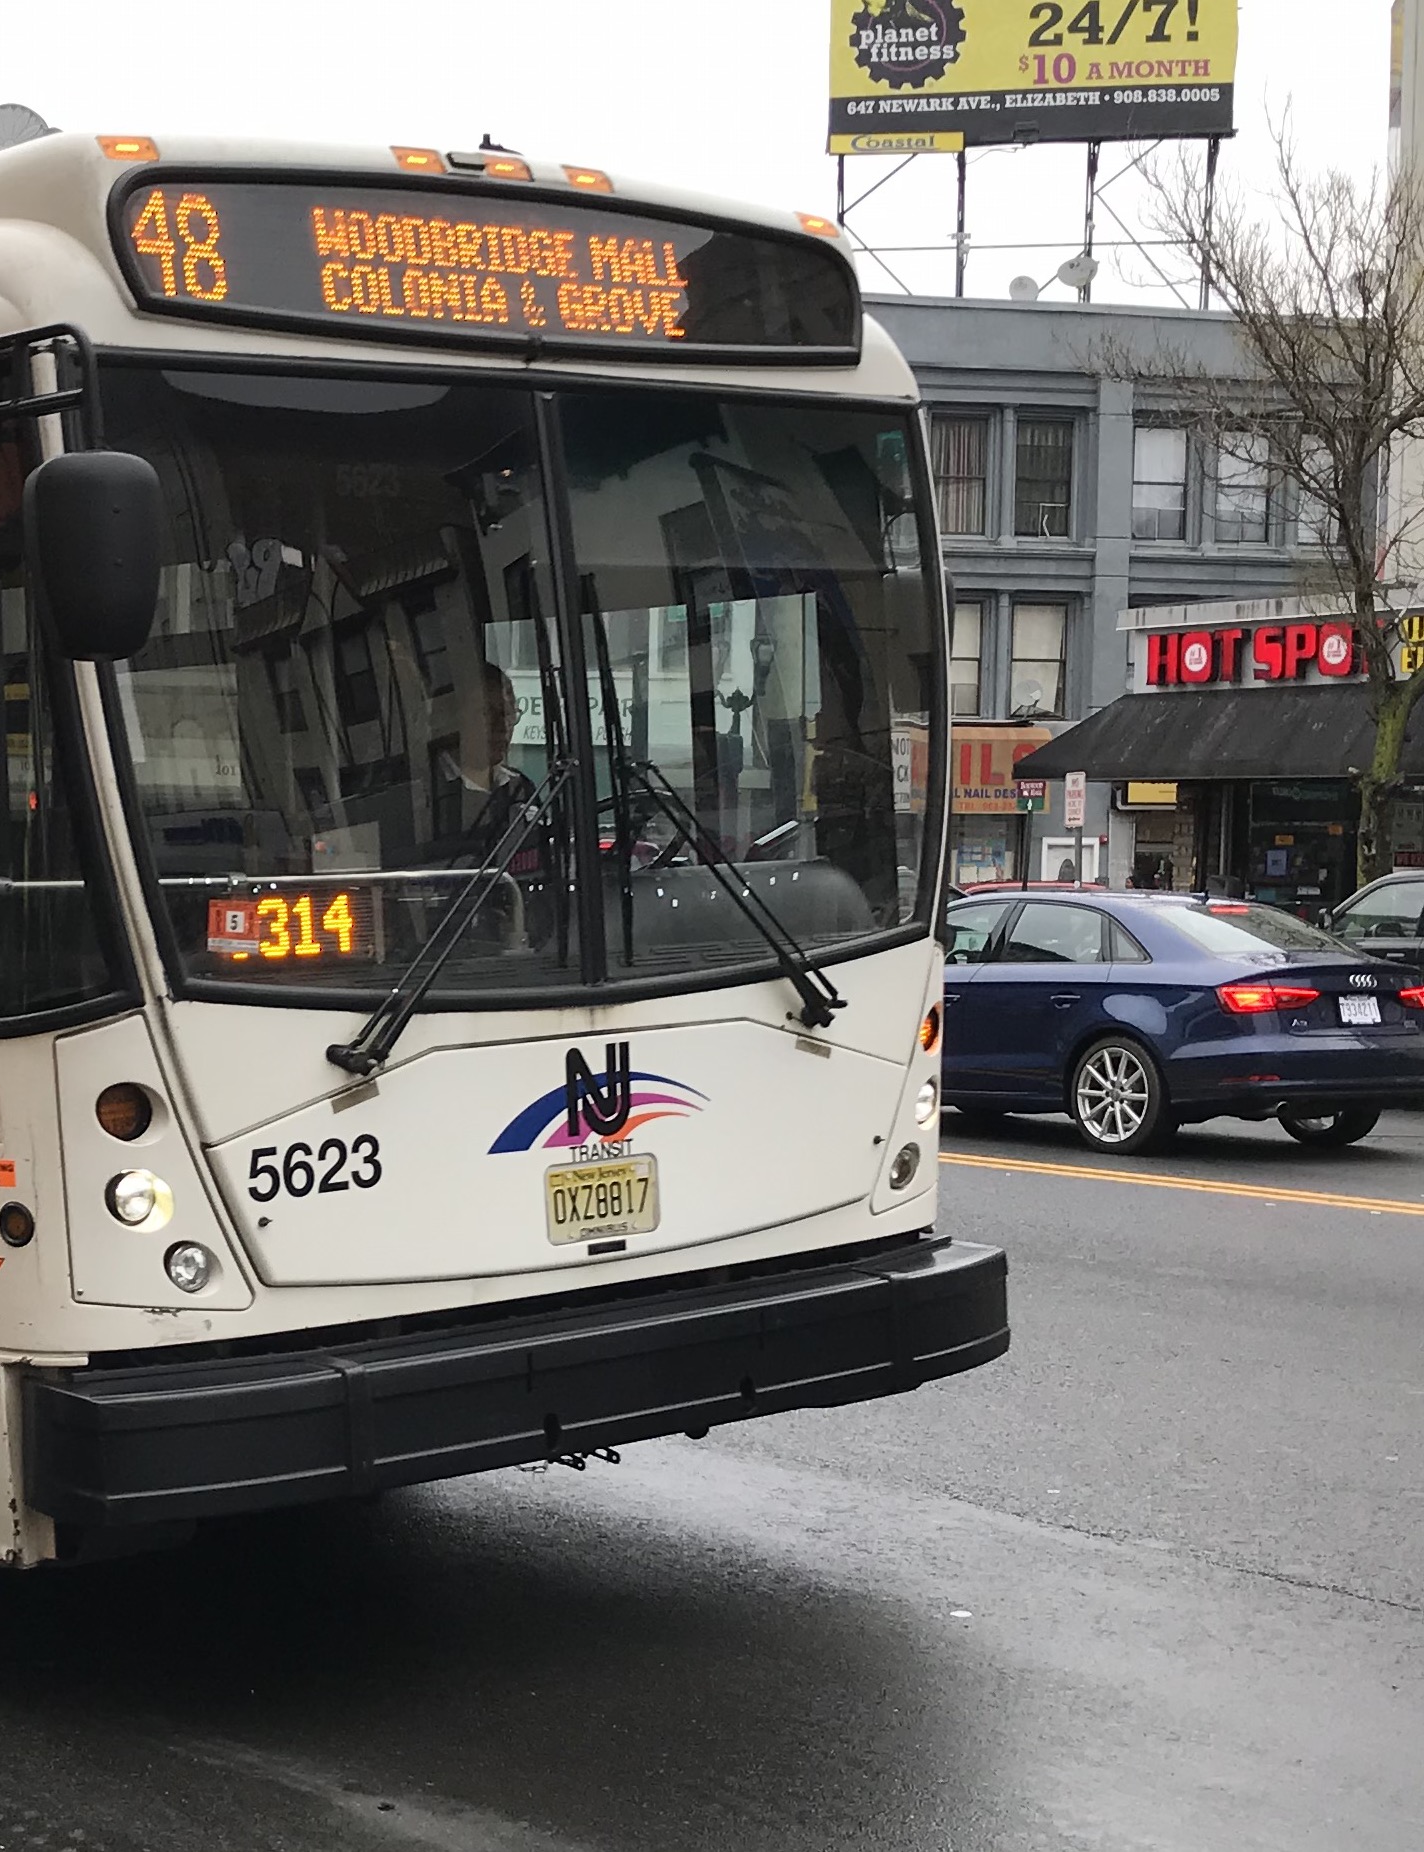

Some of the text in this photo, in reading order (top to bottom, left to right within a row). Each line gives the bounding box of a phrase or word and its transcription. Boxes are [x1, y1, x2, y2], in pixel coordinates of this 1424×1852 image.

[859, 23, 938, 49] planet
[1028, 0, 1199, 47] 24/7!
[870, 43, 955, 62] fitness
[1018, 52, 1211, 85] $10 A MONTH
[847, 88, 1220, 115] 647 NEWARK AVE., ELIZABETH 908.838.0005
[851, 134, 936, 152] Coastal
[131, 189, 689, 300] 48 WOODBRIDGE MALL
[321, 261, 510, 325] COLONIA
[557, 282, 686, 339] GROVE
[1147, 620, 1385, 686] HOT SPO
[964, 788, 991, 799] NAIL
[230, 914, 239, 931] 5
[232, 894, 354, 958] 314
[565, 1041, 630, 1137] NJ
[569, 1138, 633, 1163] TRANSIT
[248, 1133, 383, 1203] 5623
[573, 1166, 628, 1183] New Jersey
[579, 1221, 628, 1238] OMNIBUS
